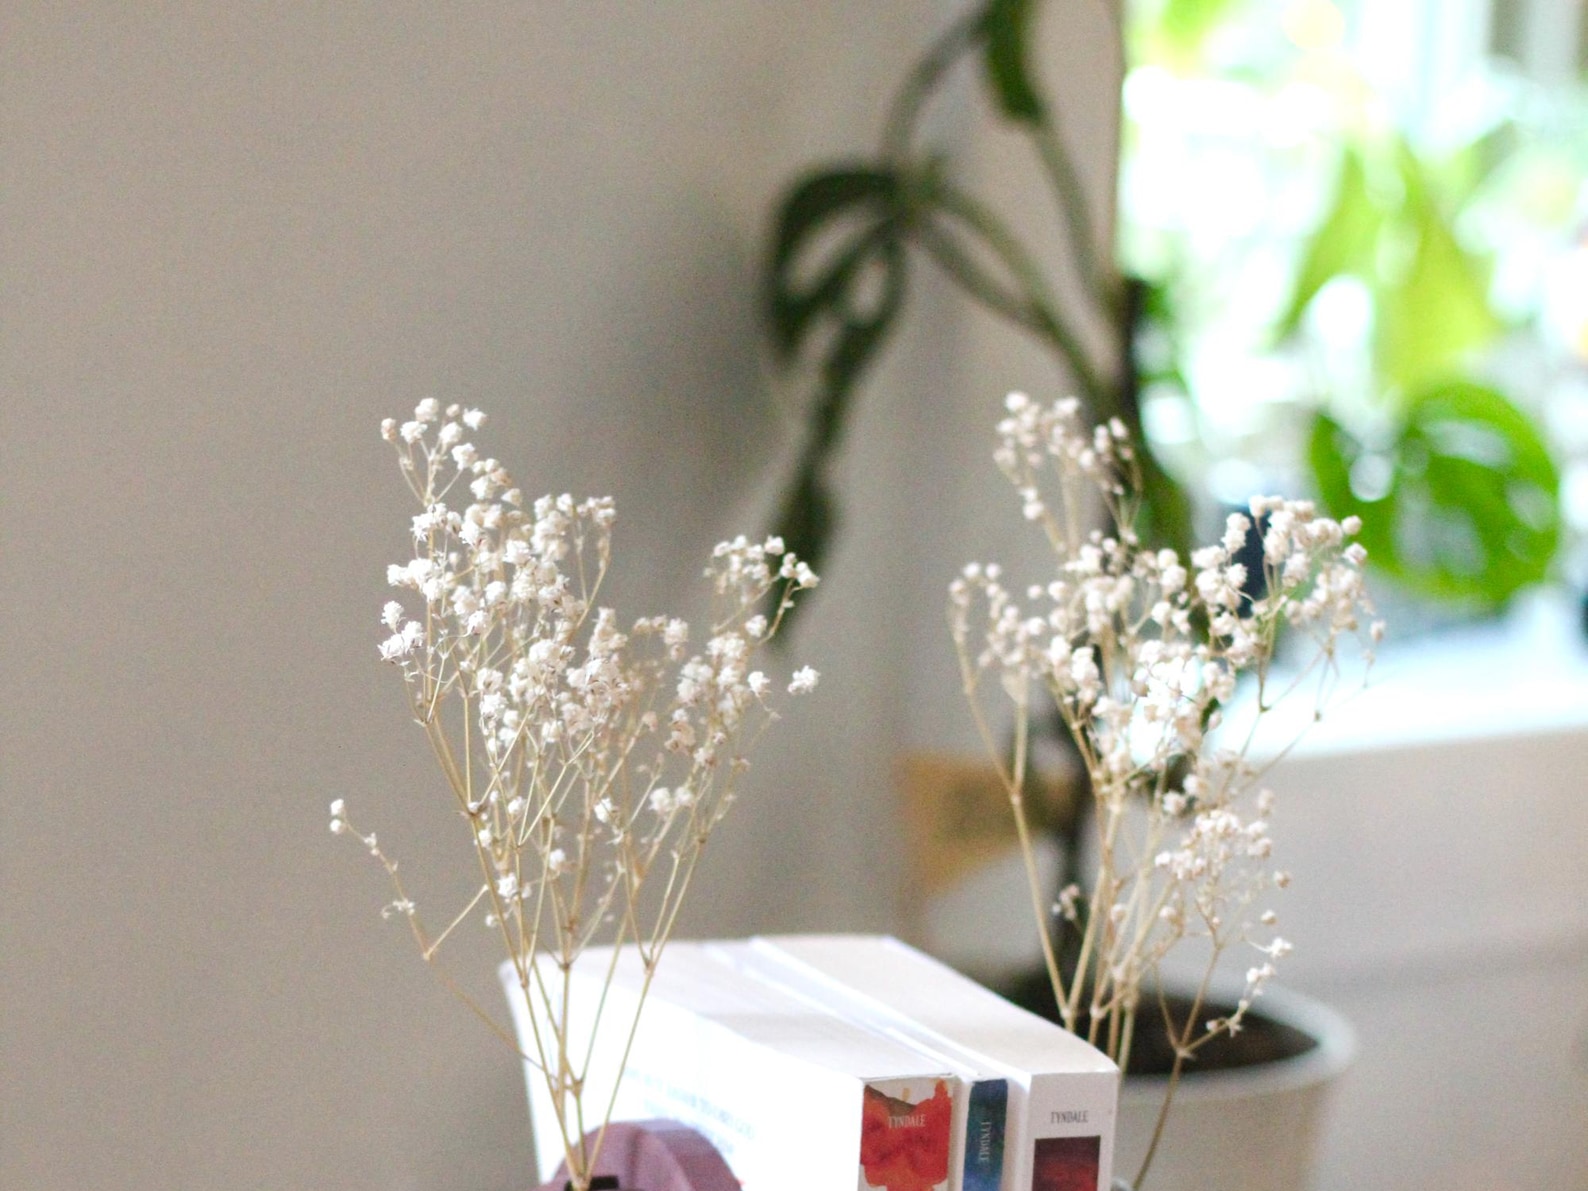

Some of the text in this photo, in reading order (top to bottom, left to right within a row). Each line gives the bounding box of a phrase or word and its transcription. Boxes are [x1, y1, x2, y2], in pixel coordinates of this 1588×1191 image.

[888, 1114, 927, 1129] TYNDALE
[1050, 1110, 1089, 1124] TYNDALE
[978, 1120, 993, 1164] TYNDALE
